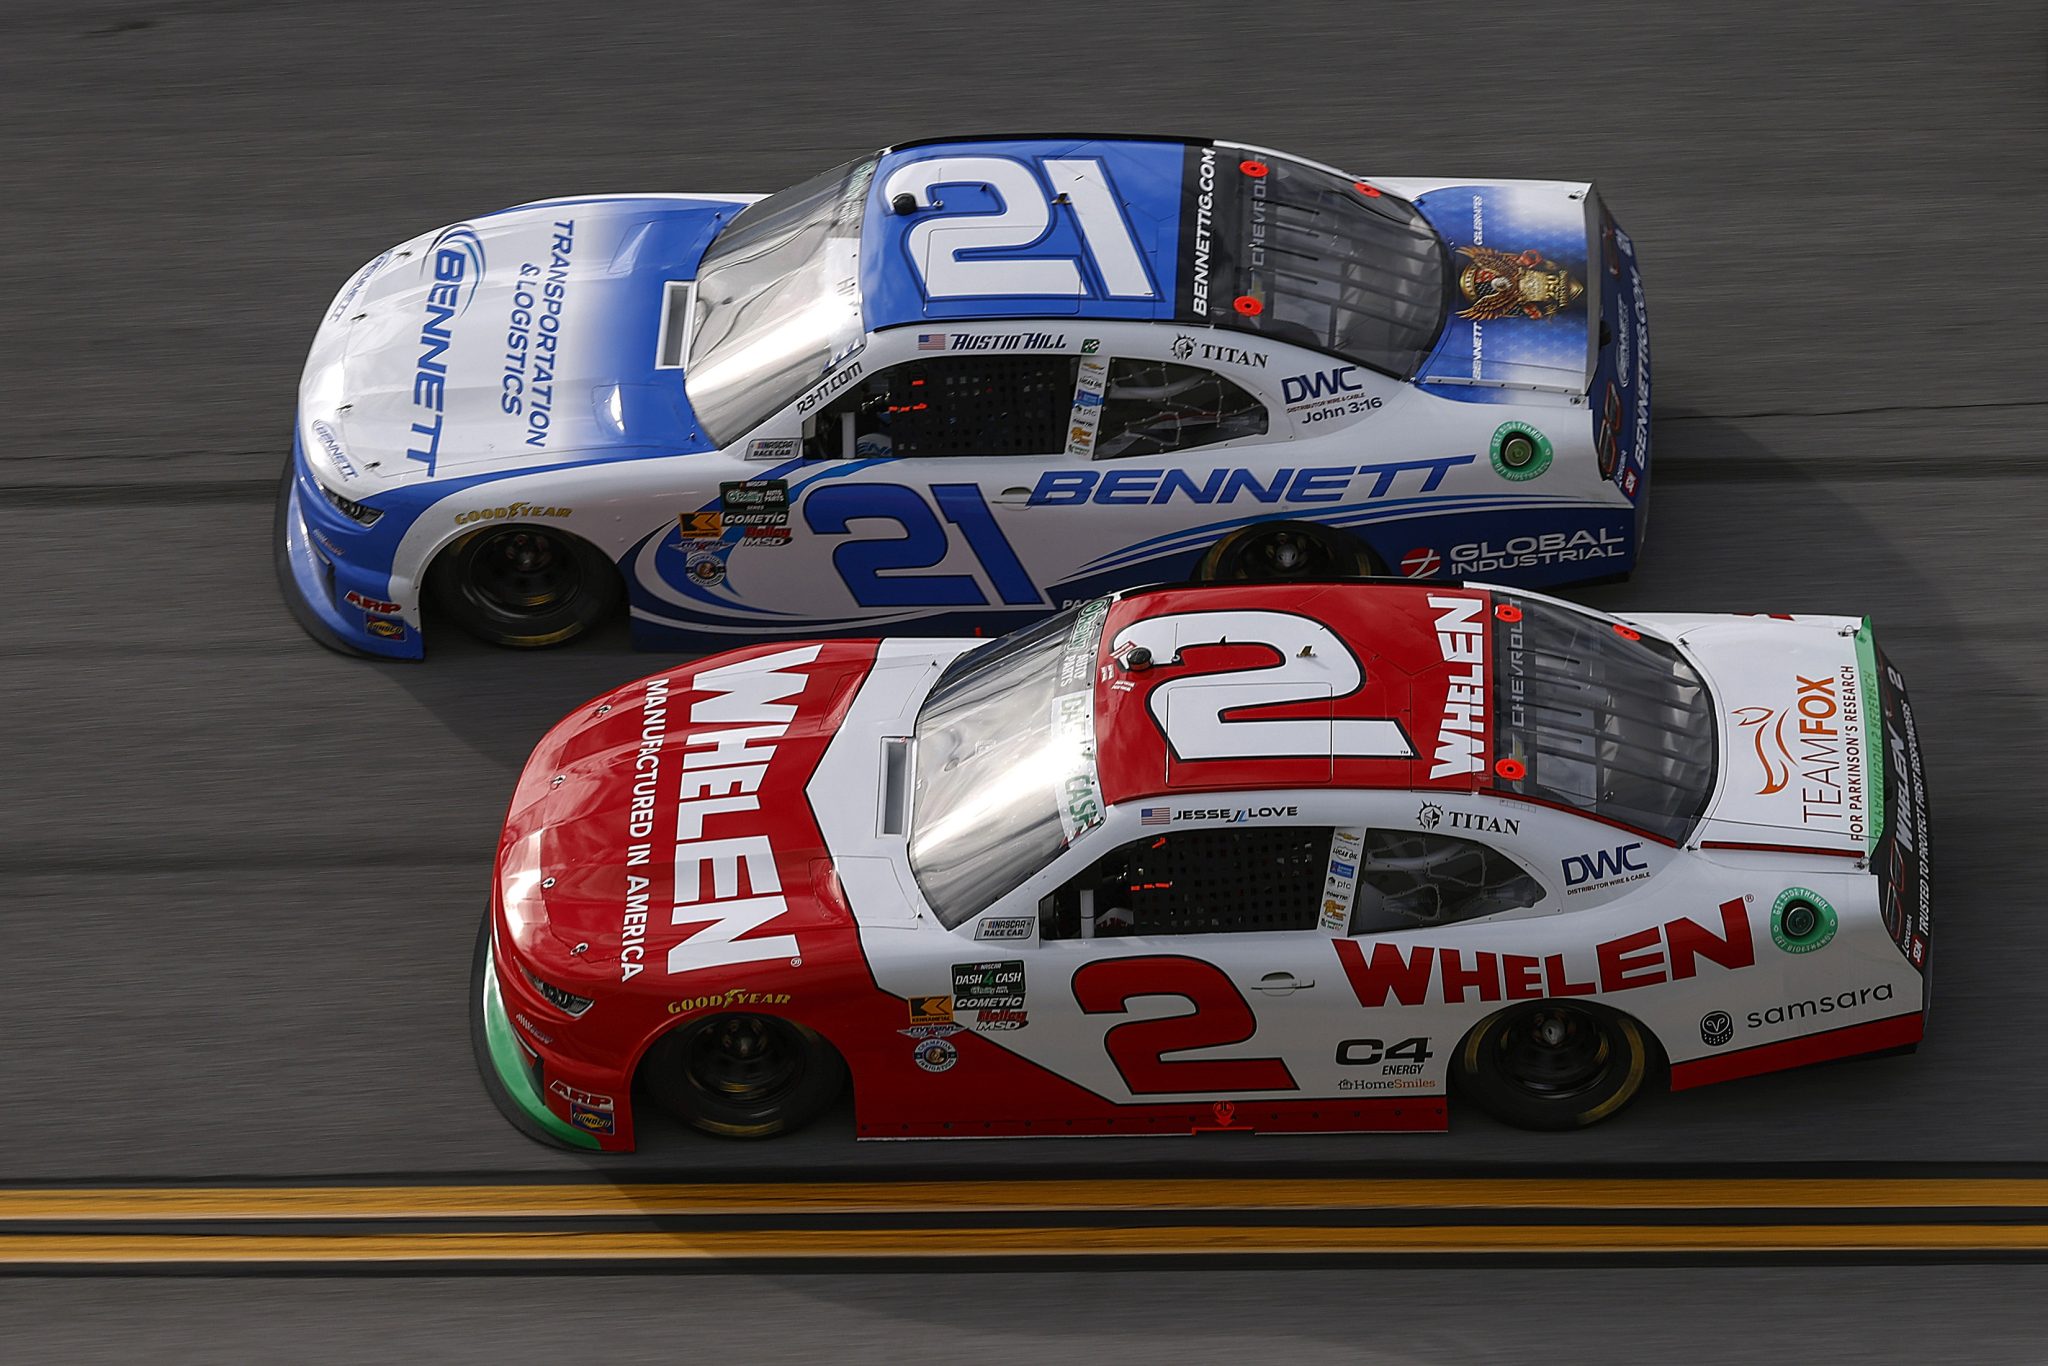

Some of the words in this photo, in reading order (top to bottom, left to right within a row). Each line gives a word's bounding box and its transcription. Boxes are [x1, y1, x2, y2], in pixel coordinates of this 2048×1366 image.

[884, 157, 1155, 297] 21
[1193, 148, 1217, 317] BENNETTIG.COM
[518, 262, 541, 279] &
[500, 281, 538, 417] LOGISTICS
[525, 219, 574, 448] TRANSPORTATION
[950, 333, 1021, 350] AUSTIN
[1021, 332, 1068, 350] HILL
[406, 246, 467, 479] BENNETT
[1201, 343, 1269, 369] TITAN
[1472, 322, 1483, 381] BENNETT
[1281, 365, 1363, 405] DWC
[1302, 406, 1346, 425] John
[1348, 396, 1384, 414] 3:16
[315, 425, 360, 479] BENNETT
[1025, 455, 1477, 507] BENNETT
[454, 501, 574, 525] GOODYEAR
[724, 511, 787, 524] COMETIC
[744, 537, 785, 547] MSD
[803, 482, 1046, 607] 21
[1450, 525, 1625, 562] GLOBAL
[1451, 544, 1626, 577] INDUSTRIAL
[344, 589, 402, 615] ARP
[1060, 655, 1076, 688] PARTS
[1074, 653, 1089, 679] AUTO
[1509, 597, 1525, 728] CHEVROLT
[1887, 665, 1904, 691] 2
[1112, 610, 1415, 760] 2
[1427, 596, 1485, 781] WHELEN
[1841, 665, 1856, 724] RESEARCH
[629, 678, 669, 839] MANUFACTURED
[1845, 725, 1863, 810] PARKINSON'S
[1887, 723, 1914, 853] WHELEN
[1912, 773, 1926, 809] FIRST
[668, 643, 824, 975] WHELEN
[1173, 808, 1232, 822] JESSE
[1248, 806, 1299, 819] LOVE
[1449, 810, 1521, 837] TITAN
[1850, 813, 1864, 842] FOR
[1916, 810, 1930, 863] PROTECT
[627, 843, 651, 867] IN
[1561, 842, 1648, 887] DWC
[1918, 861, 1929, 877] TO
[1567, 881, 1609, 896] DISTRIBUTOR
[1609, 878, 1625, 887] WIRE
[1630, 871, 1652, 881] CABLE
[1917, 877, 1931, 936] TRUSTED
[621, 874, 650, 983] AMERICA
[984, 928, 1006, 937] RACE
[1006, 928, 1024, 937] CAR
[994, 920, 1027, 929] NASCAR
[1331, 895, 1756, 1009] WHELEN
[955, 973, 984, 986] DASH
[982, 970, 995, 986] 4
[995, 972, 1022, 984] CASH
[667, 988, 792, 1015] GOODYEAR
[956, 994, 1023, 1009] COMETIC
[1746, 982, 1895, 1030] samsara
[976, 1021, 1021, 1031] MSD
[1071, 953, 1301, 1096] 2
[1336, 1037, 1434, 1066] C4
[1354, 1078, 1436, 1090] HomeSmiles
[1382, 1064, 1424, 1076] ENERGY
[550, 1080, 614, 1111] ARP
